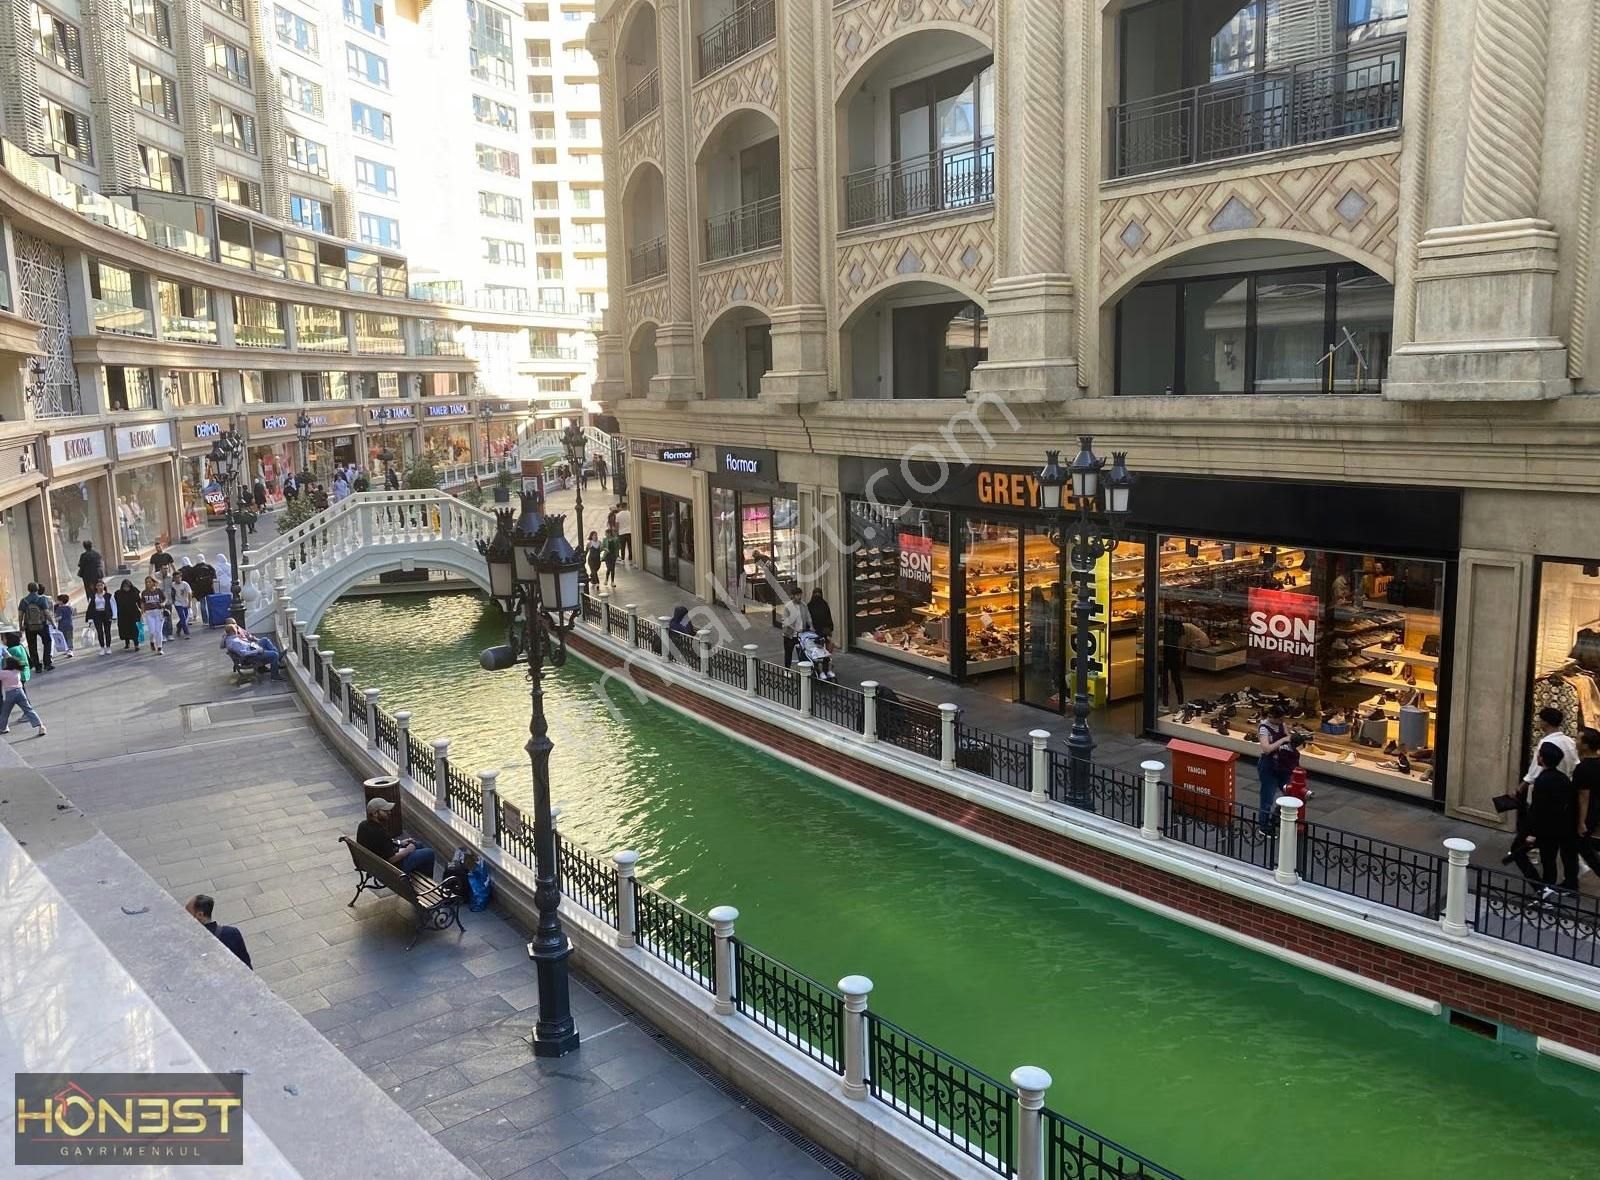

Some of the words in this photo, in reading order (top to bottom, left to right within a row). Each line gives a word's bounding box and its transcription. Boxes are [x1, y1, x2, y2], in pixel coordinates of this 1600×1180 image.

[663, 451, 693, 460] flormar
[726, 453, 758, 473] flormar
[900, 550, 932, 573] SON
[1249, 611, 1316, 643] SON
[1187, 765, 1207, 776] YANGIN
